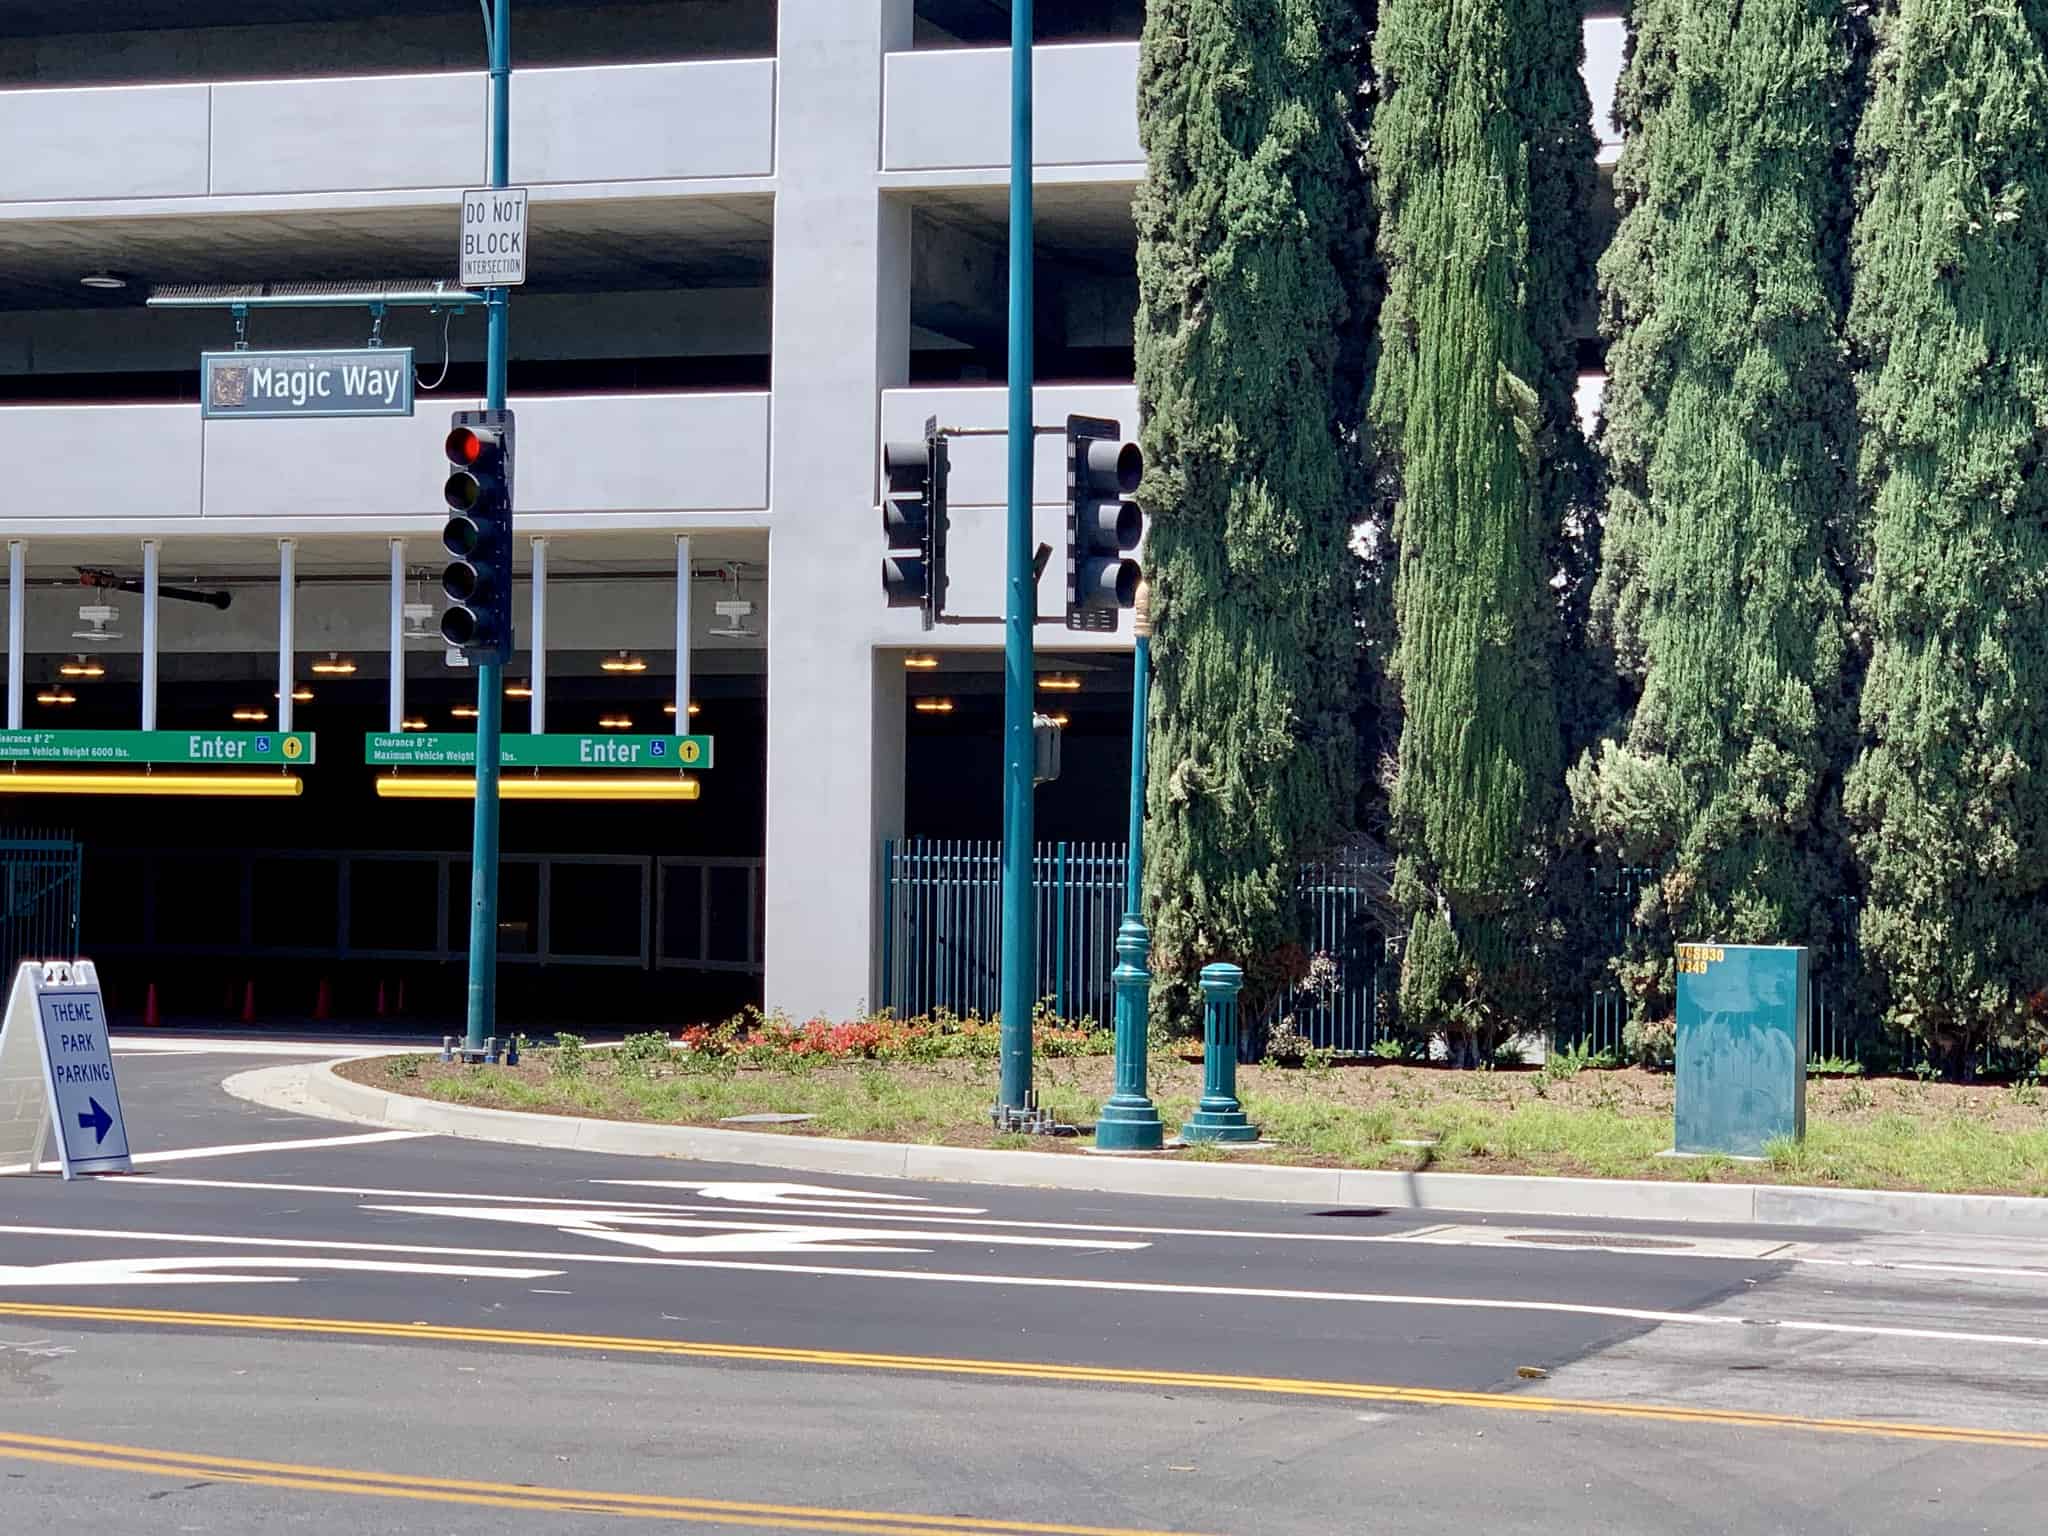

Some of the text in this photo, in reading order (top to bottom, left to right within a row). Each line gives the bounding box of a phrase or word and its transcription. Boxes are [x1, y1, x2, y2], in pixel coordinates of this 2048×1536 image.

[466, 201, 522, 224] DO NOT
[465, 232, 520, 255] BLOCK
[464, 259, 521, 274] INTERSECTION
[252, 363, 400, 406] Magic Way
[0, 746, 129, 758] aximum Vehicle Weight 6000 lbs.
[189, 735, 247, 758] Enter
[374, 737, 414, 747] Clearance
[580, 738, 641, 762] Enter
[374, 751, 517, 762] Maximum Vehicle Weight lbs.
[51, 1002, 93, 1022] THEME
[61, 1033, 95, 1052] PARK
[56, 1063, 110, 1084] PARKING
